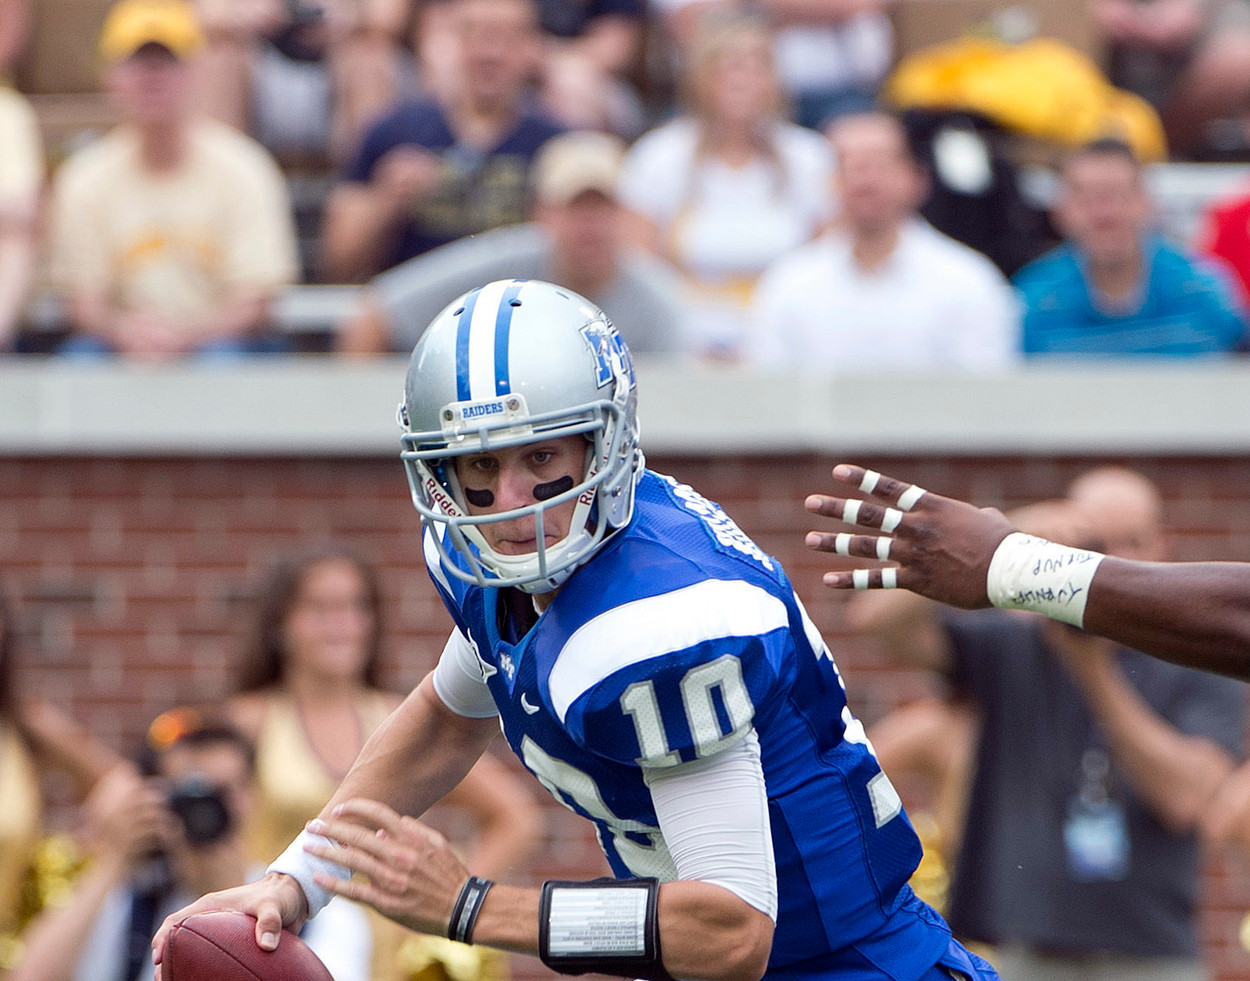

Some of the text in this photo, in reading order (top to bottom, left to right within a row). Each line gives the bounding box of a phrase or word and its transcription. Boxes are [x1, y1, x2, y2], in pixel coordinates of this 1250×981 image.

[462, 402, 504, 419] RAIDERS
[426, 477, 463, 518] Ridde
[620, 653, 756, 769] 10
